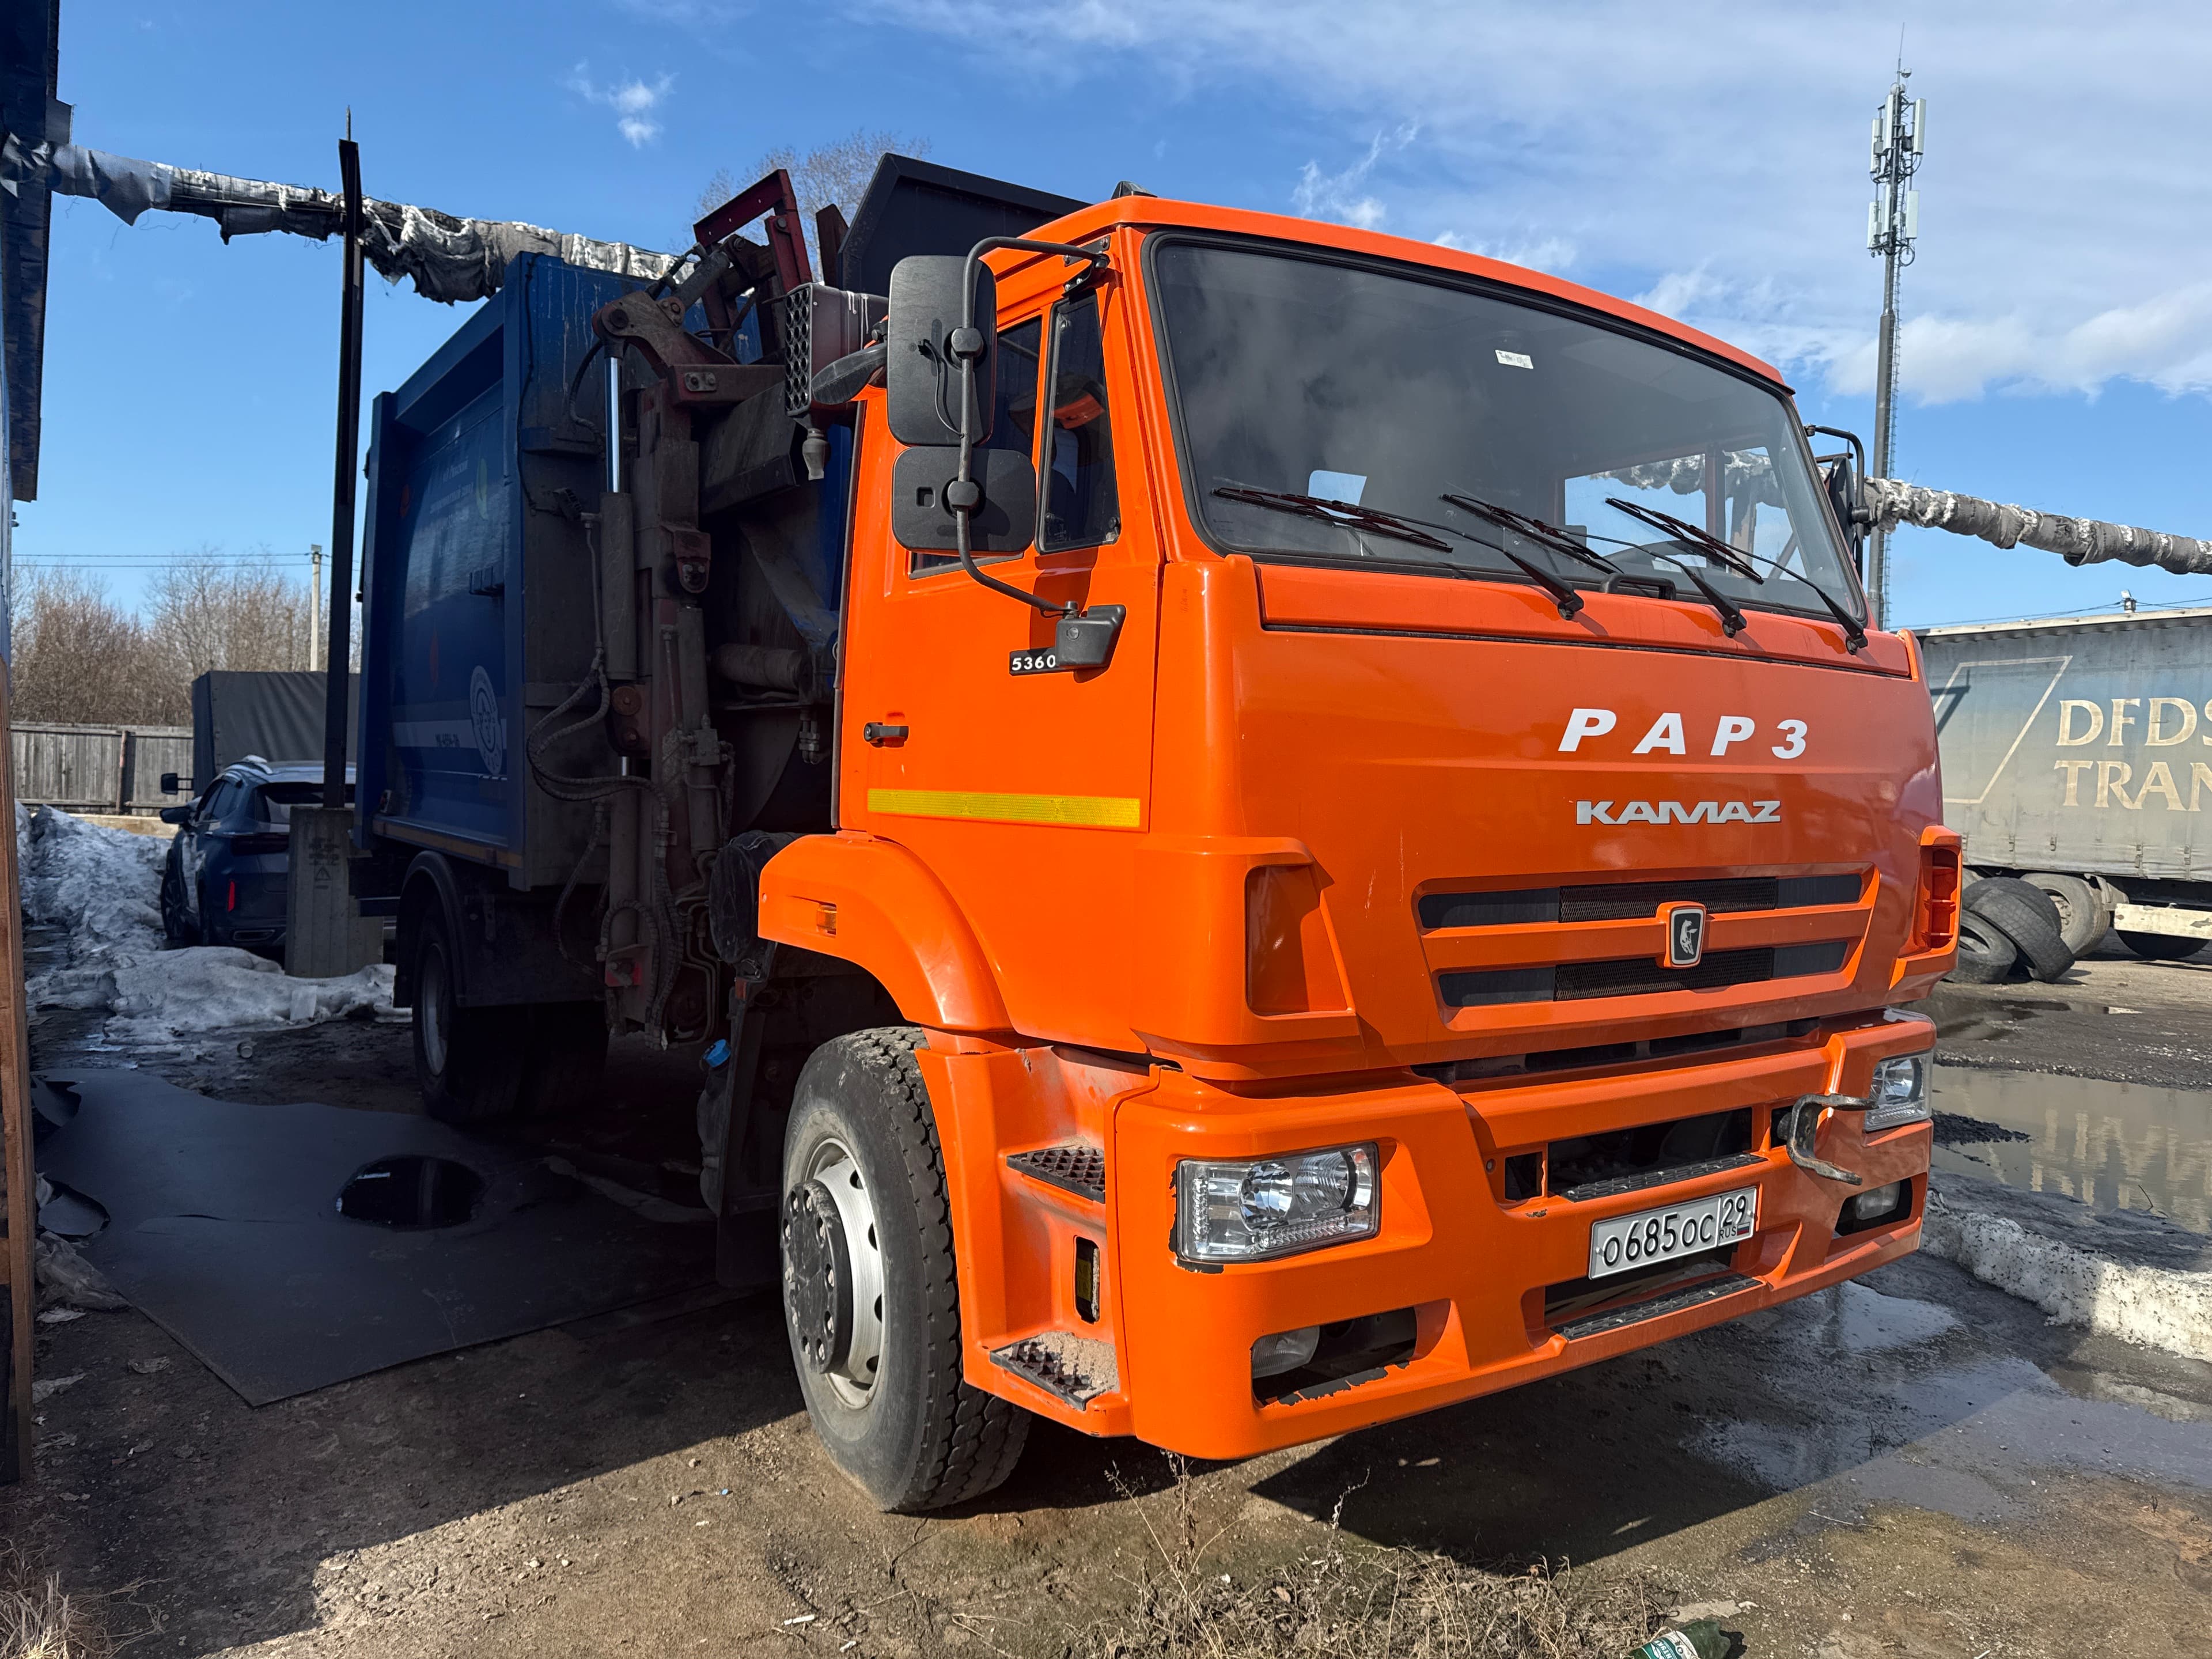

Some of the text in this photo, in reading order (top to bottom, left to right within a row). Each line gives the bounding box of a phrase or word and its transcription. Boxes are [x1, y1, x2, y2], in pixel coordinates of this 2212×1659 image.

[1012, 654, 1056, 671] 5360
[1575, 801, 1782, 825] KAMAZ
[1721, 1194, 1747, 1228] 29
[1719, 1225, 1737, 1240] RUS
